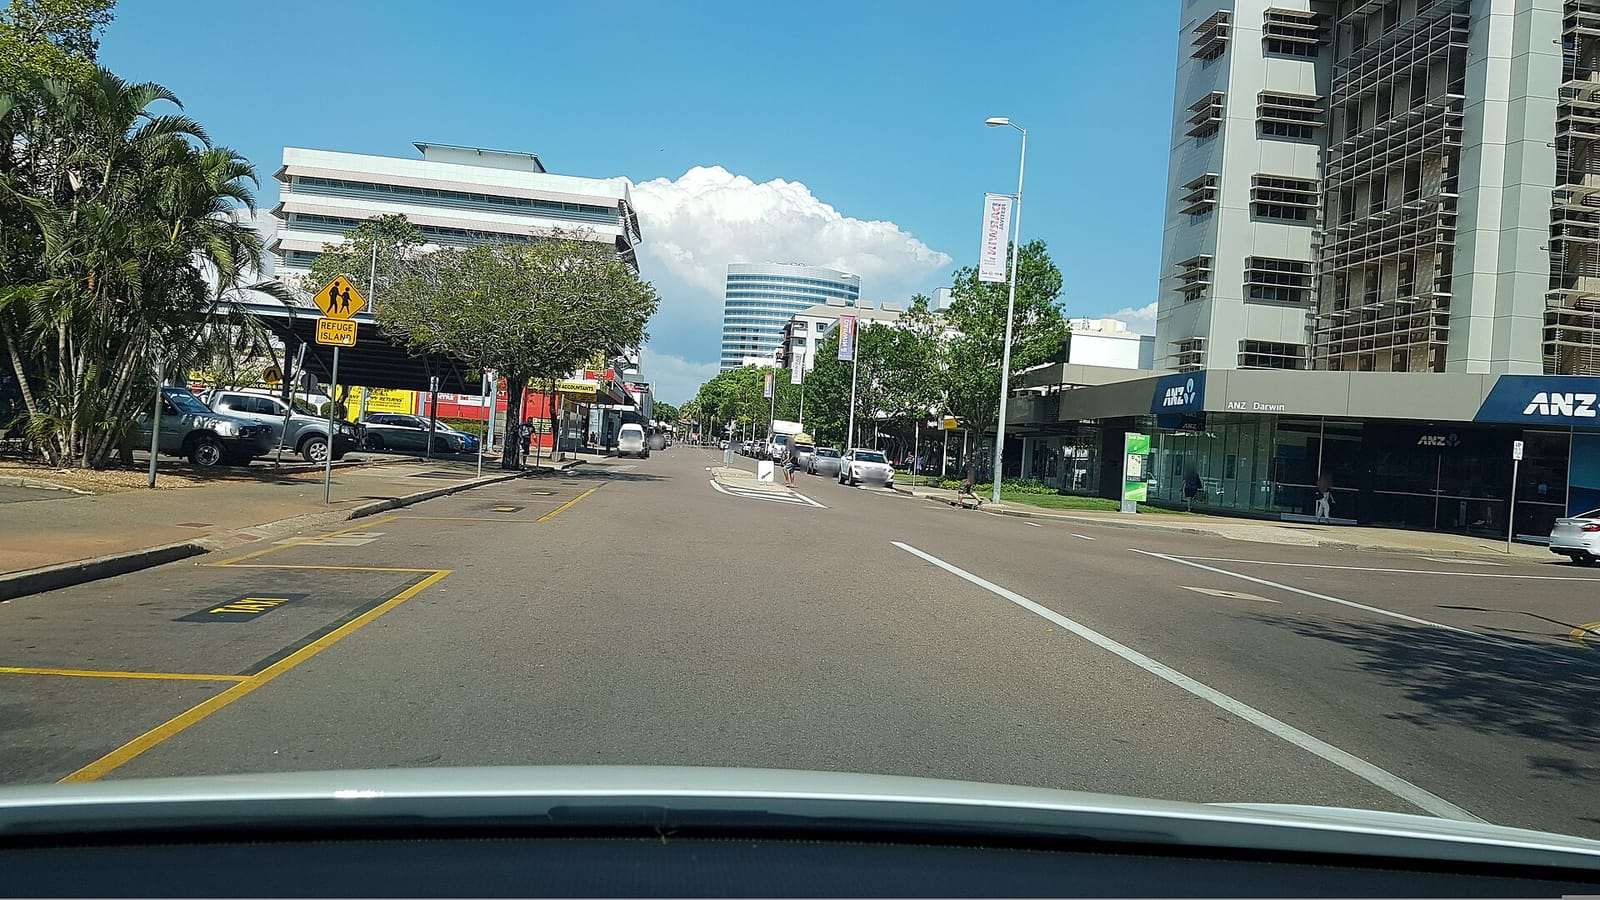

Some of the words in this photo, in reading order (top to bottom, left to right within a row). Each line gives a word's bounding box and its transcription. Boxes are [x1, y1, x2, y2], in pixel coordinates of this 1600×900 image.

[988, 202, 1001, 256] DARWIN
[320, 321, 354, 332] REFUGE
[320, 332, 352, 342] ISLAND
[562, 383, 594, 392] ACCOUNTANTS
[1163, 386, 1184, 407] ANZ
[1227, 401, 1247, 411] ANZ
[1253, 402, 1286, 412] Darwin
[1523, 392, 1597, 418] ANZ
[1417, 435, 1446, 446] ANZ
[208, 597, 289, 614] TAXI
